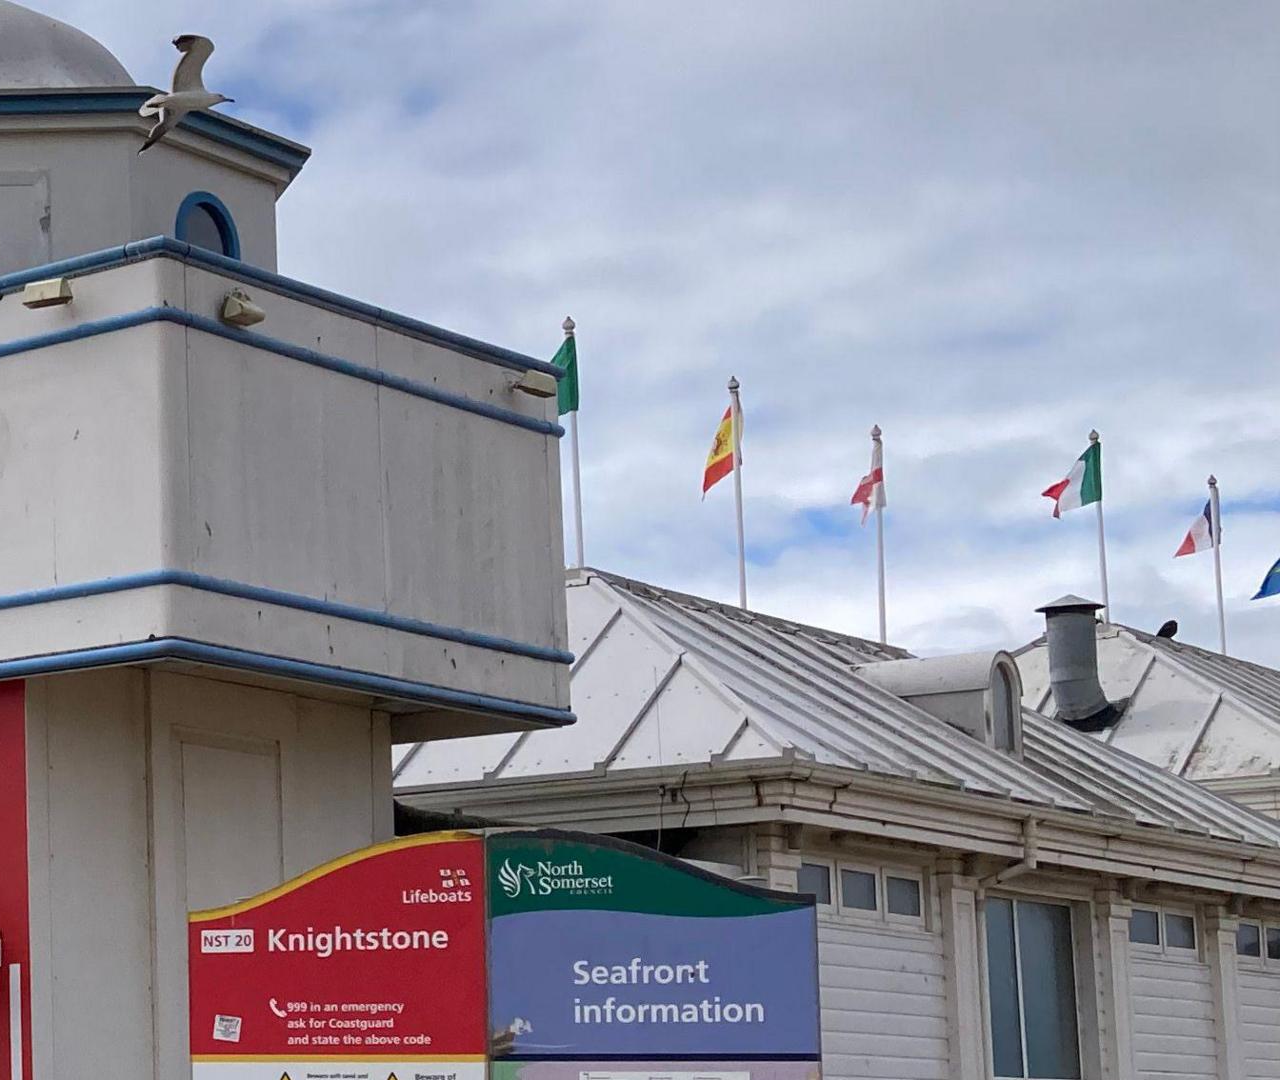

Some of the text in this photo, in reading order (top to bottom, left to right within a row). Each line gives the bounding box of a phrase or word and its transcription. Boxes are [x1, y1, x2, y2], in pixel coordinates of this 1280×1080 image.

[538, 860, 583, 876] North
[539, 876, 613, 895] Somerset
[402, 889, 472, 904] Lifeboats
[204, 934, 251, 947] NST 20
[268, 926, 448, 957] Knightstone
[573, 958, 709, 985] Seafront
[287, 1002, 404, 1016] 999 in an emergency
[575, 996, 764, 1024] information
[287, 1018, 393, 1030] ask for Coastguard
[288, 1035, 431, 1045] and state the above code
[447, 1073, 456, 1080] of
